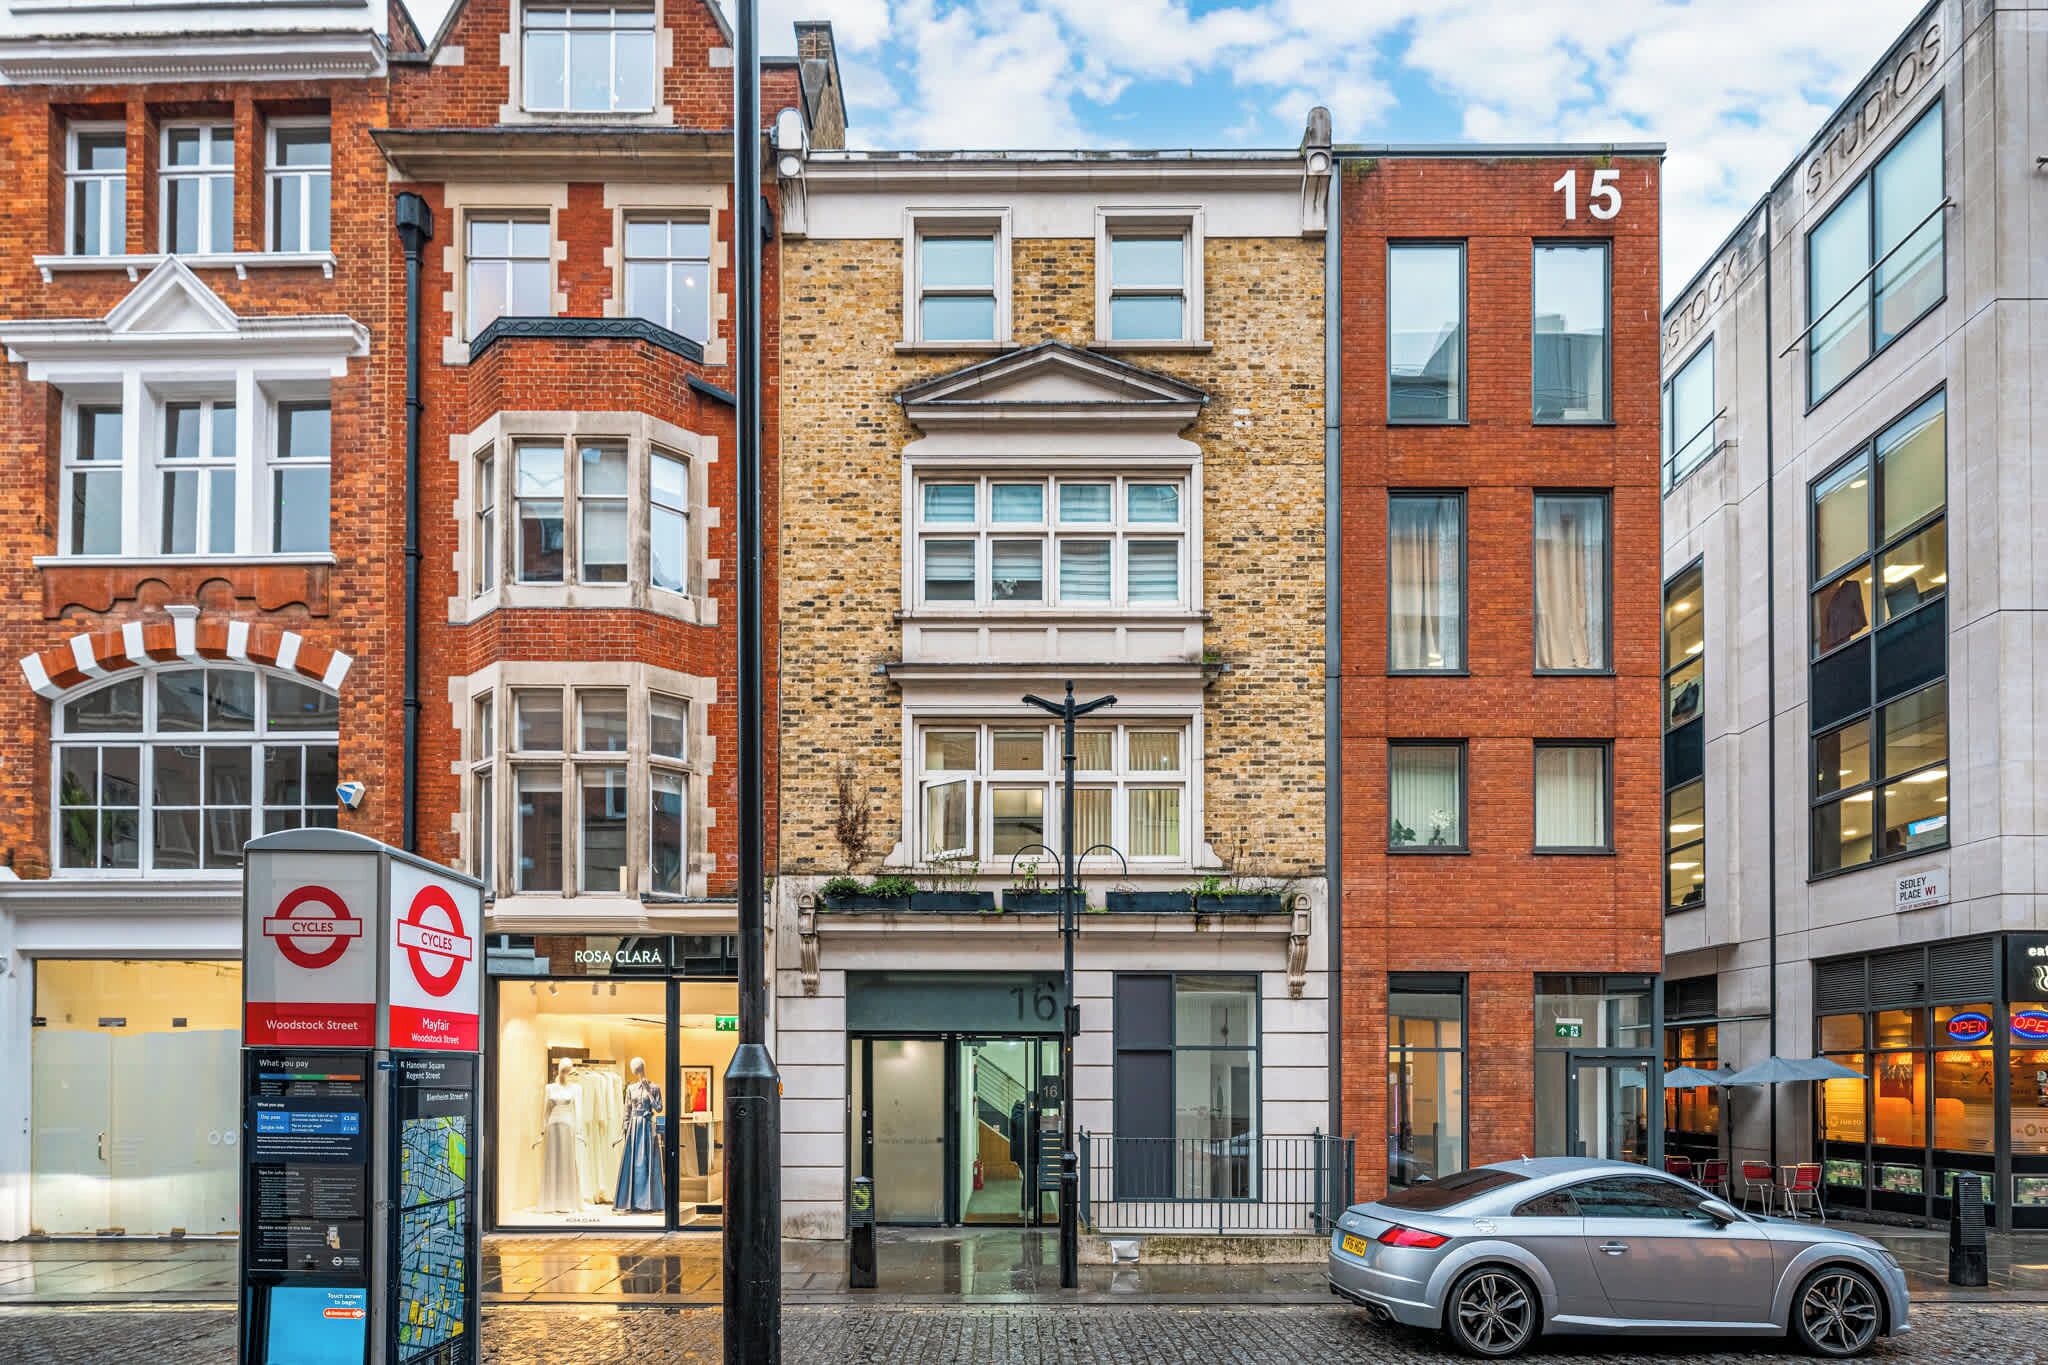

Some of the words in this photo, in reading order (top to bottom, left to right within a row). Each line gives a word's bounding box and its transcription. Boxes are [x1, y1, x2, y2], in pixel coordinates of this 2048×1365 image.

[1806, 23, 1941, 195] STUDIOS
[1553, 169, 1622, 220] 15
[1899, 875, 1927, 890] SEDLEY
[1899, 888, 1921, 901] PLACE
[1924, 884, 1936, 896] W1
[291, 921, 334, 933] CYCLES
[421, 932, 453, 951] CYCLES
[574, 950, 612, 963] ROSA
[1010, 983, 1057, 1022] 16
[266, 1019, 324, 1031] Woodstock
[326, 1020, 359, 1031] Street
[422, 1017, 450, 1032] Mayfair
[1948, 1020, 1988, 1033] OPEN
[411, 1032, 442, 1044] Woodstock
[443, 1034, 460, 1045] Street
[259, 1059, 279, 1067] What
[281, 1061, 294, 1069] you
[295, 1061, 309, 1069] pay
[1043, 1084, 1058, 1098] 16
